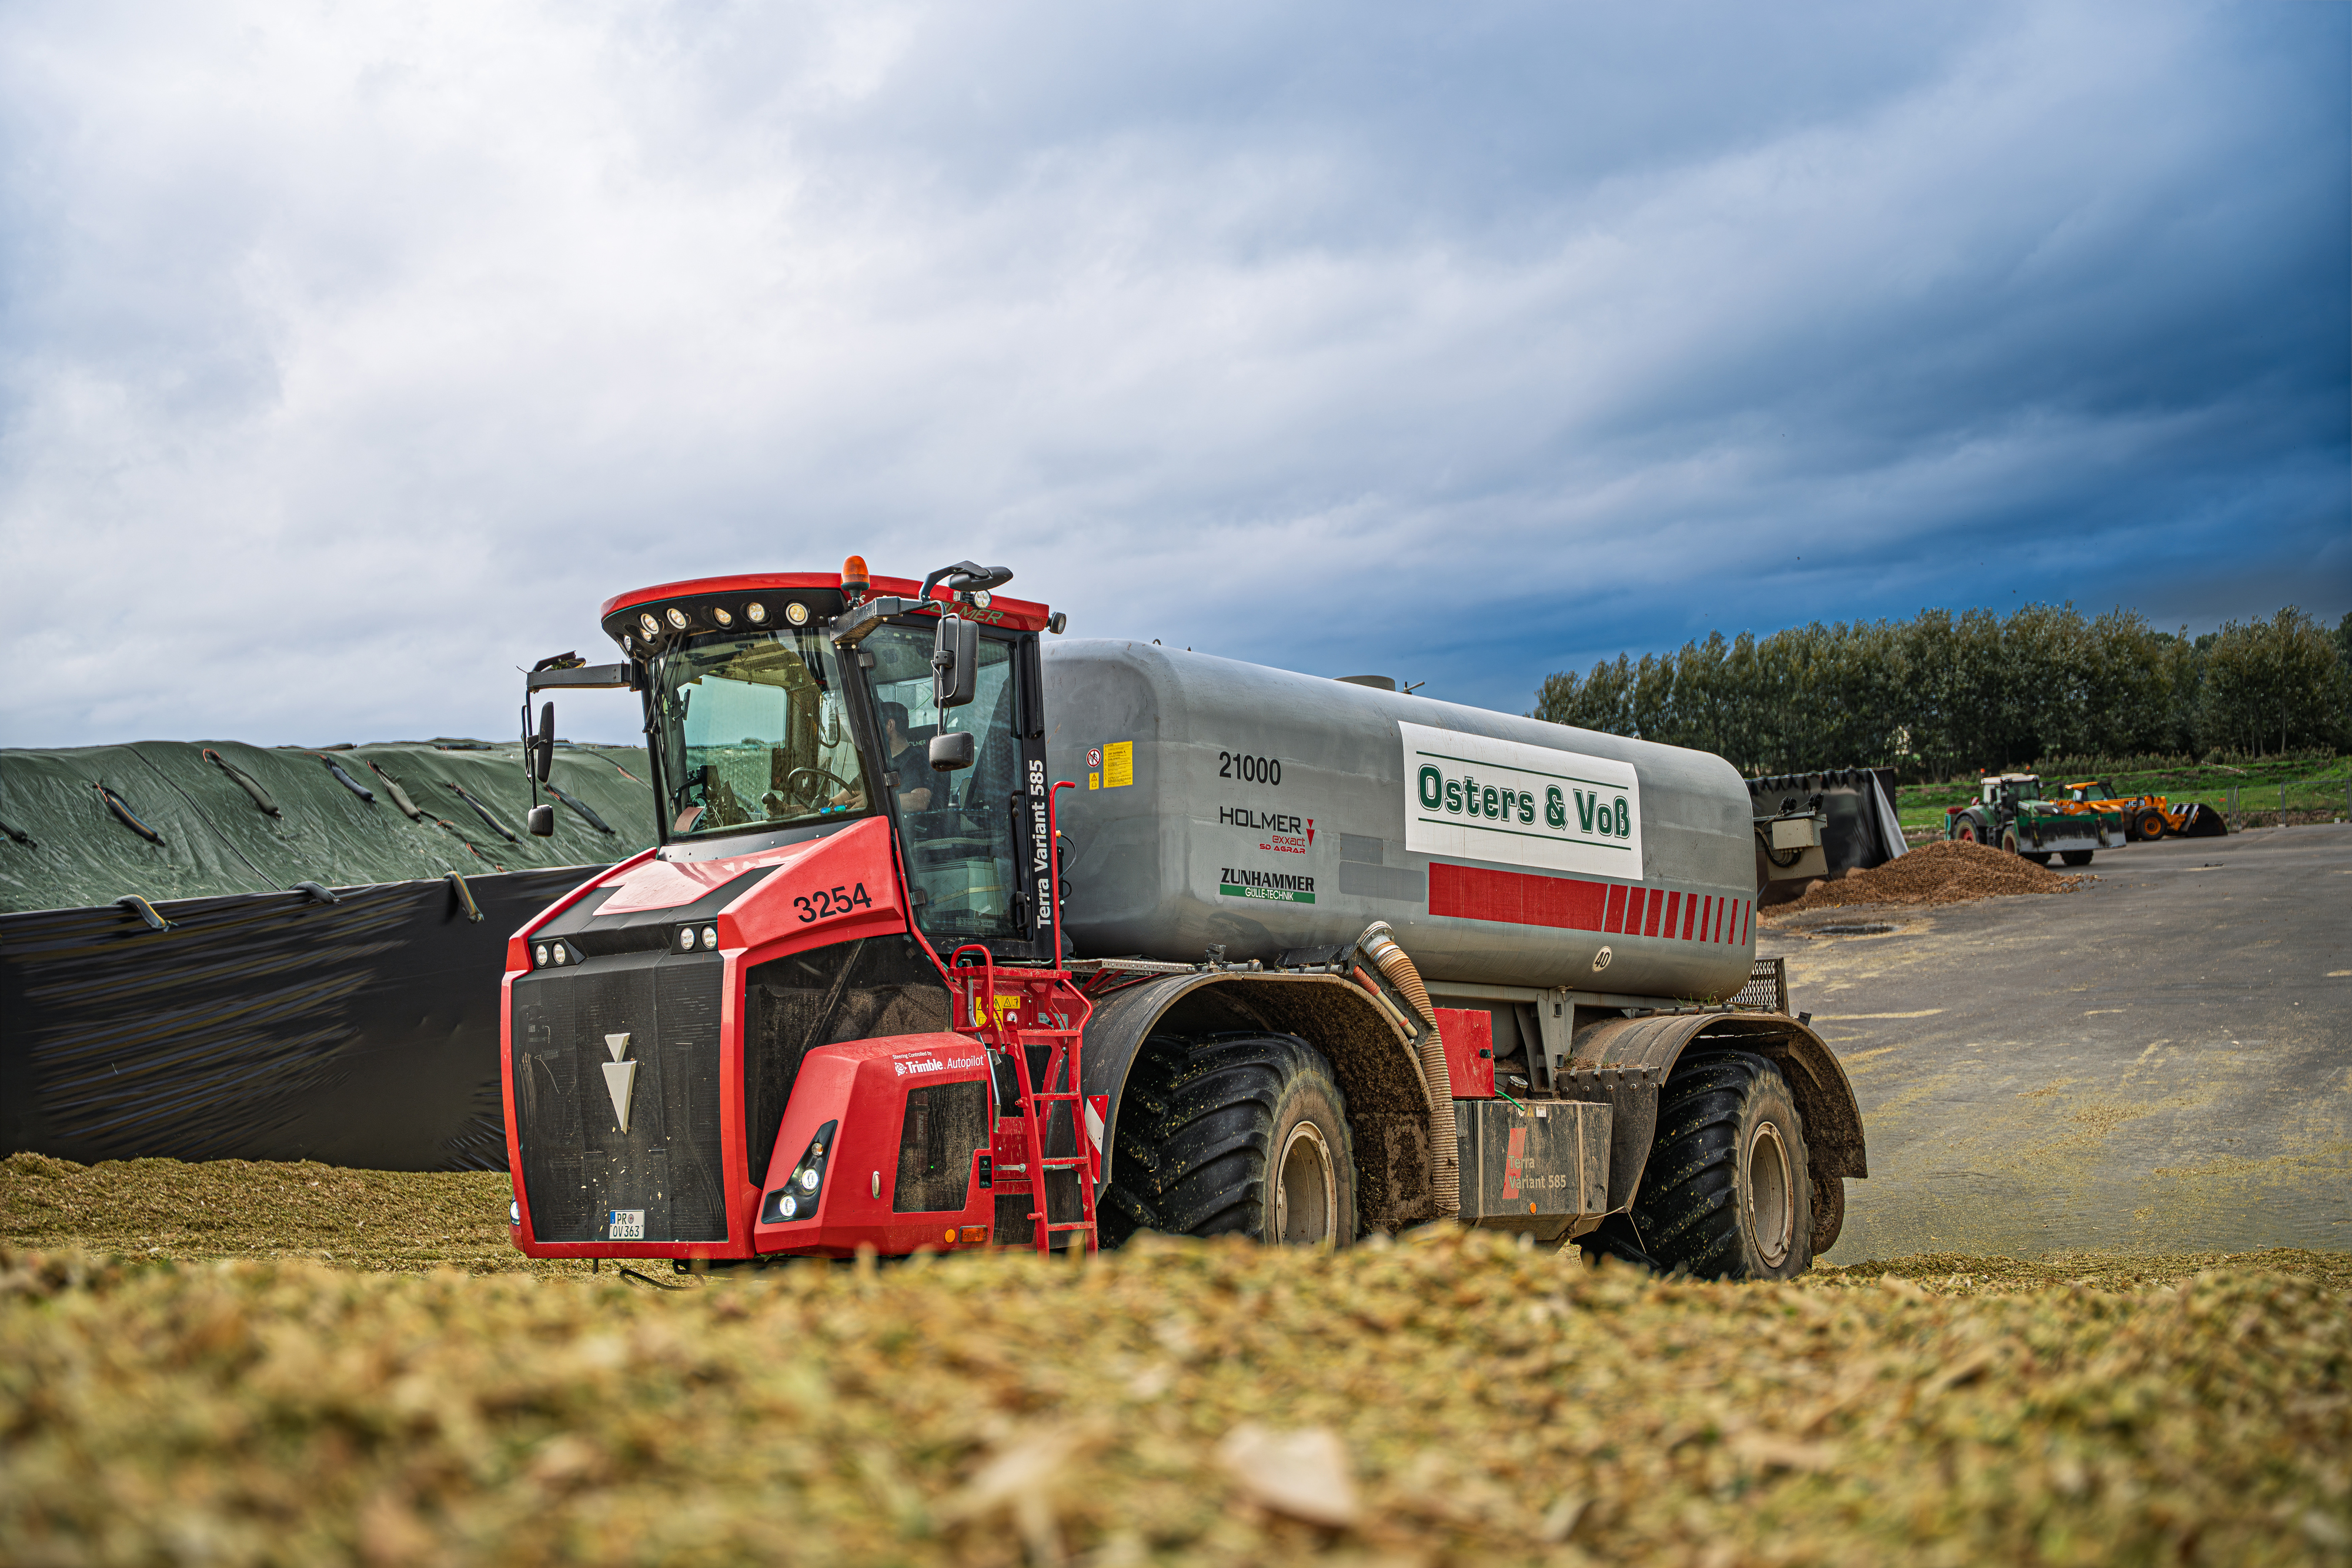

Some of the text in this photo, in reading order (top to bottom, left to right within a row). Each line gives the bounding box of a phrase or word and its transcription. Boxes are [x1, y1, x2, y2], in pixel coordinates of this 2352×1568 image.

[923, 601, 1004, 624] OLMER
[1219, 751, 1281, 786] 21000
[1418, 764, 1631, 840] Osters & Voß
[2125, 800, 2145, 808] JCB
[1220, 805, 1302, 835] HOLMER
[1030, 760, 1051, 928] Terra Variant 585
[1272, 835, 1305, 847] exxact
[1273, 845, 1306, 854] AGRAR
[1221, 868, 1314, 892] ZUNHAMMER
[794, 882, 872, 922] 3254
[1245, 887, 1294, 901] GÜLLE-TECHNIK
[1595, 952, 1611, 968] 40
[906, 1055, 984, 1074] Trimble Autopilot
[1508, 1155, 1535, 1169] Terra
[1509, 1175, 1566, 1189] Variant 585
[617, 1213, 627, 1225] PR
[613, 1226, 639, 1237] OV 363
